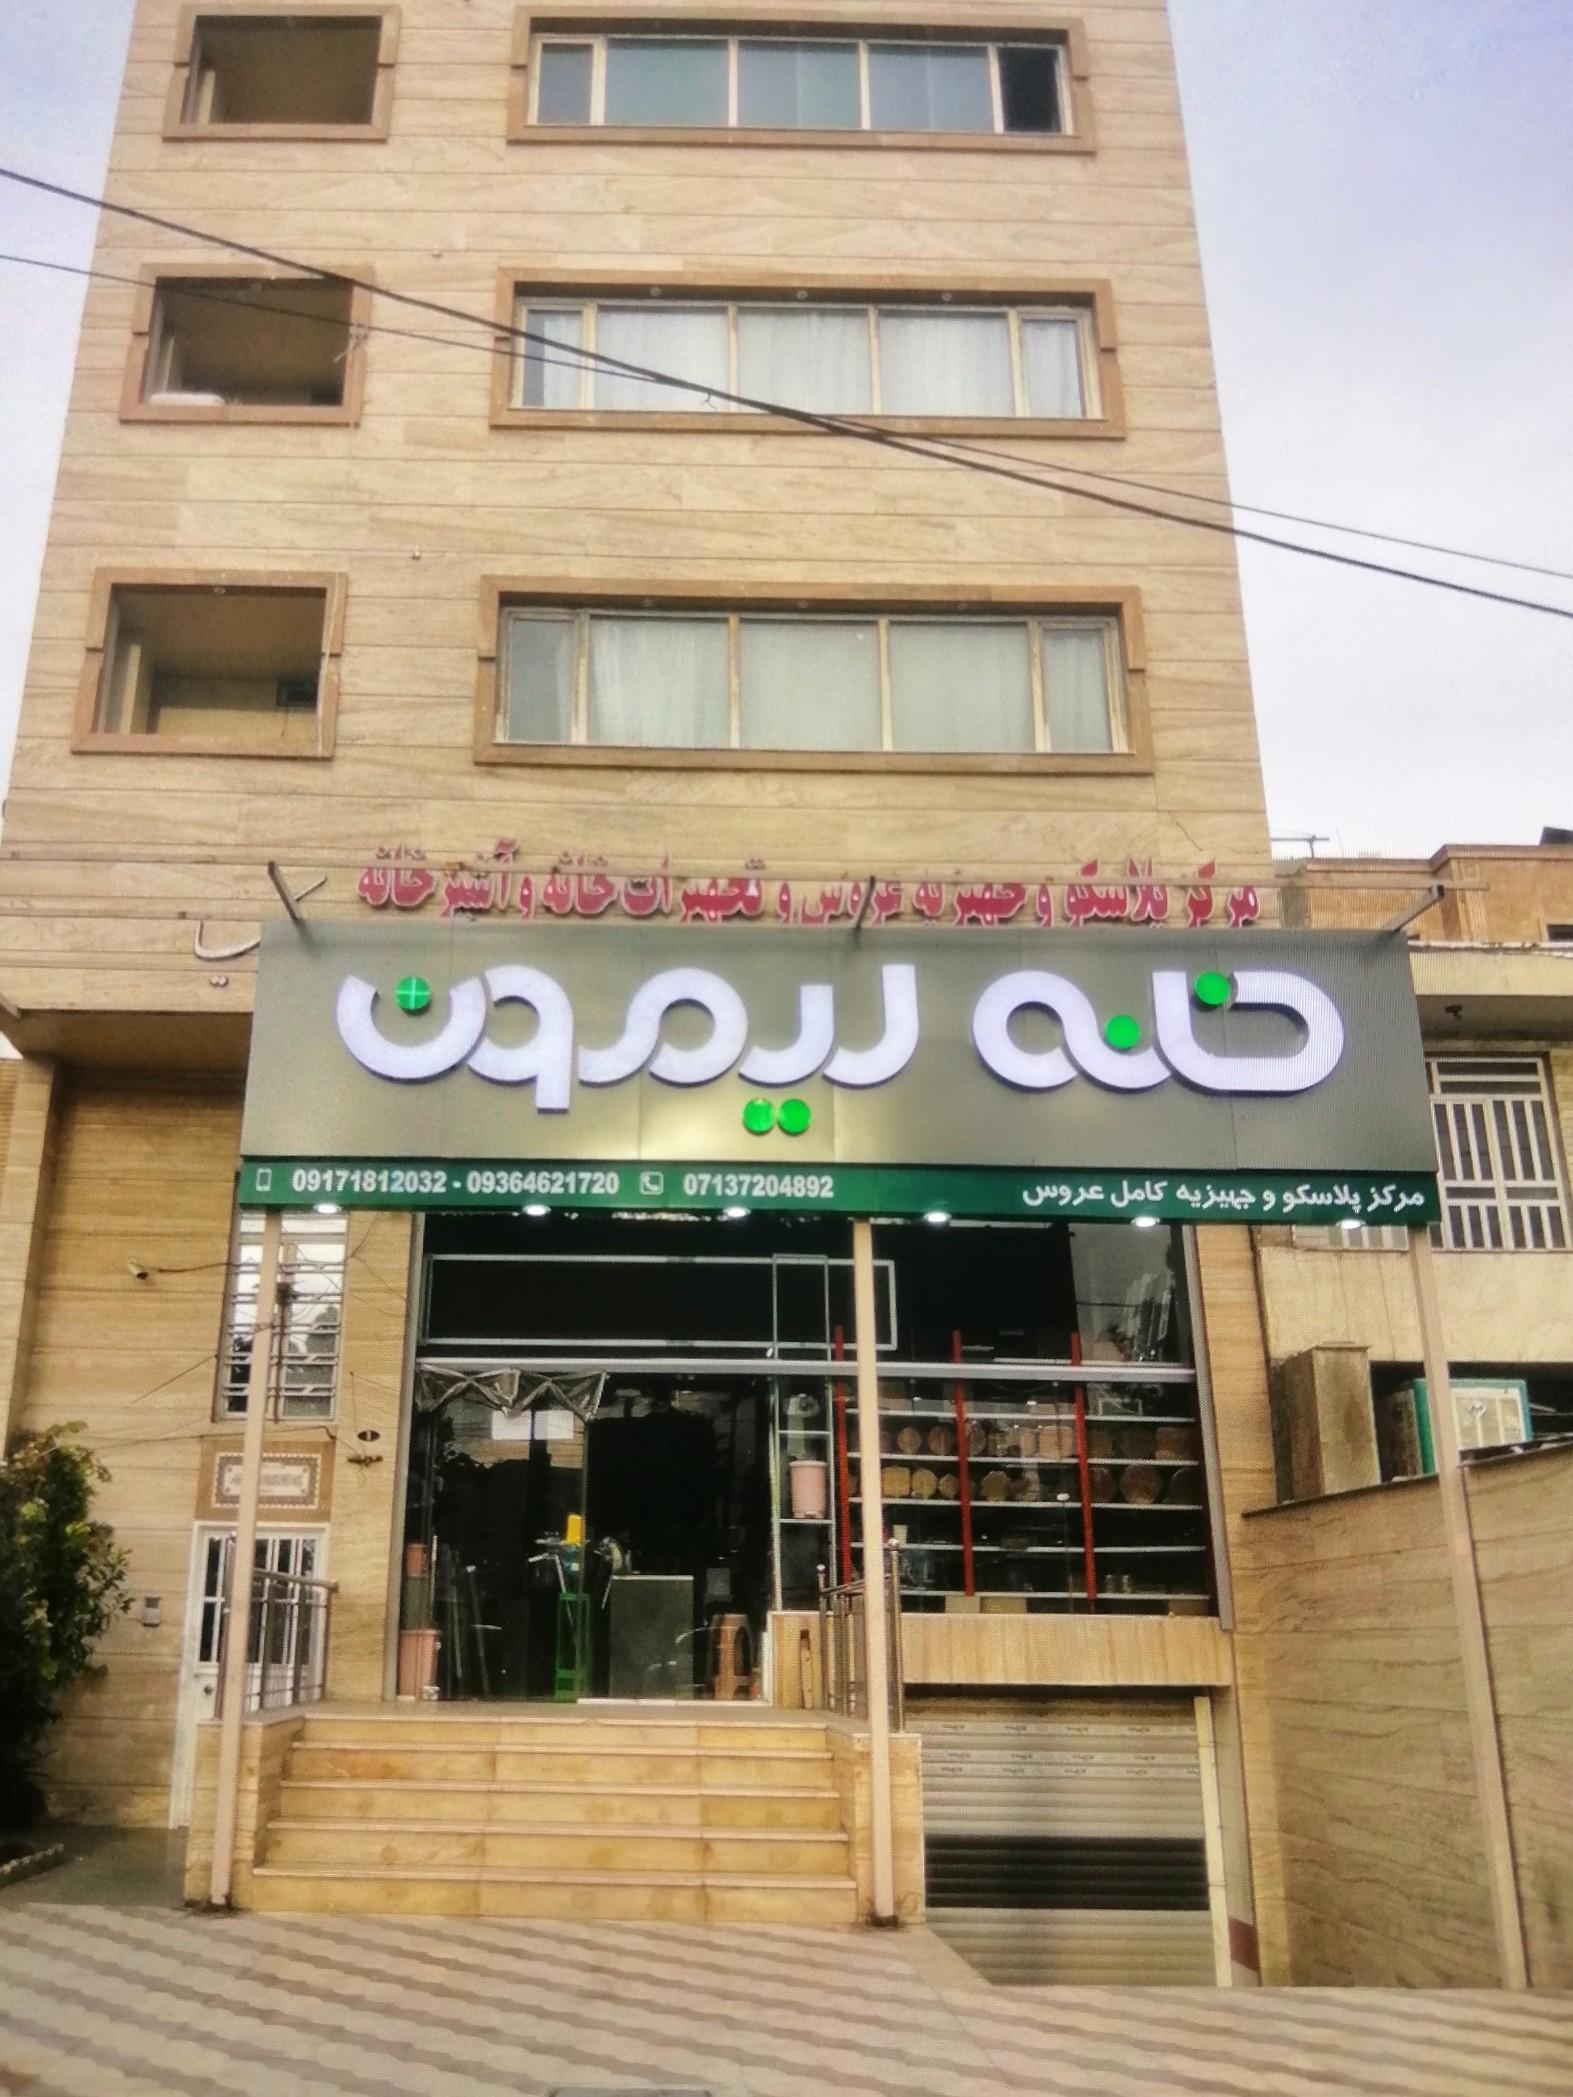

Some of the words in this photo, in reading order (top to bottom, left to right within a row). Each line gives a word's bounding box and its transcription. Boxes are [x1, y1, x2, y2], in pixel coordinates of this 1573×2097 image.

[518, 874, 535, 920] و
[775, 881, 793, 924] و
[334, 962, 921, 1135] لیمون
[291, 1168, 447, 1193] 09171812032
[467, 1170, 620, 1195] 09364621720
[683, 1172, 834, 1198] 07137204892
[1022, 1184, 1105, 1207] عروس
[1110, 1180, 1168, 1208] کامل
[1366, 1184, 1425, 1212] مرکز
[1262, 1189, 1276, 1212] و
[1282, 1184, 1362, 1214] پلاسکو
